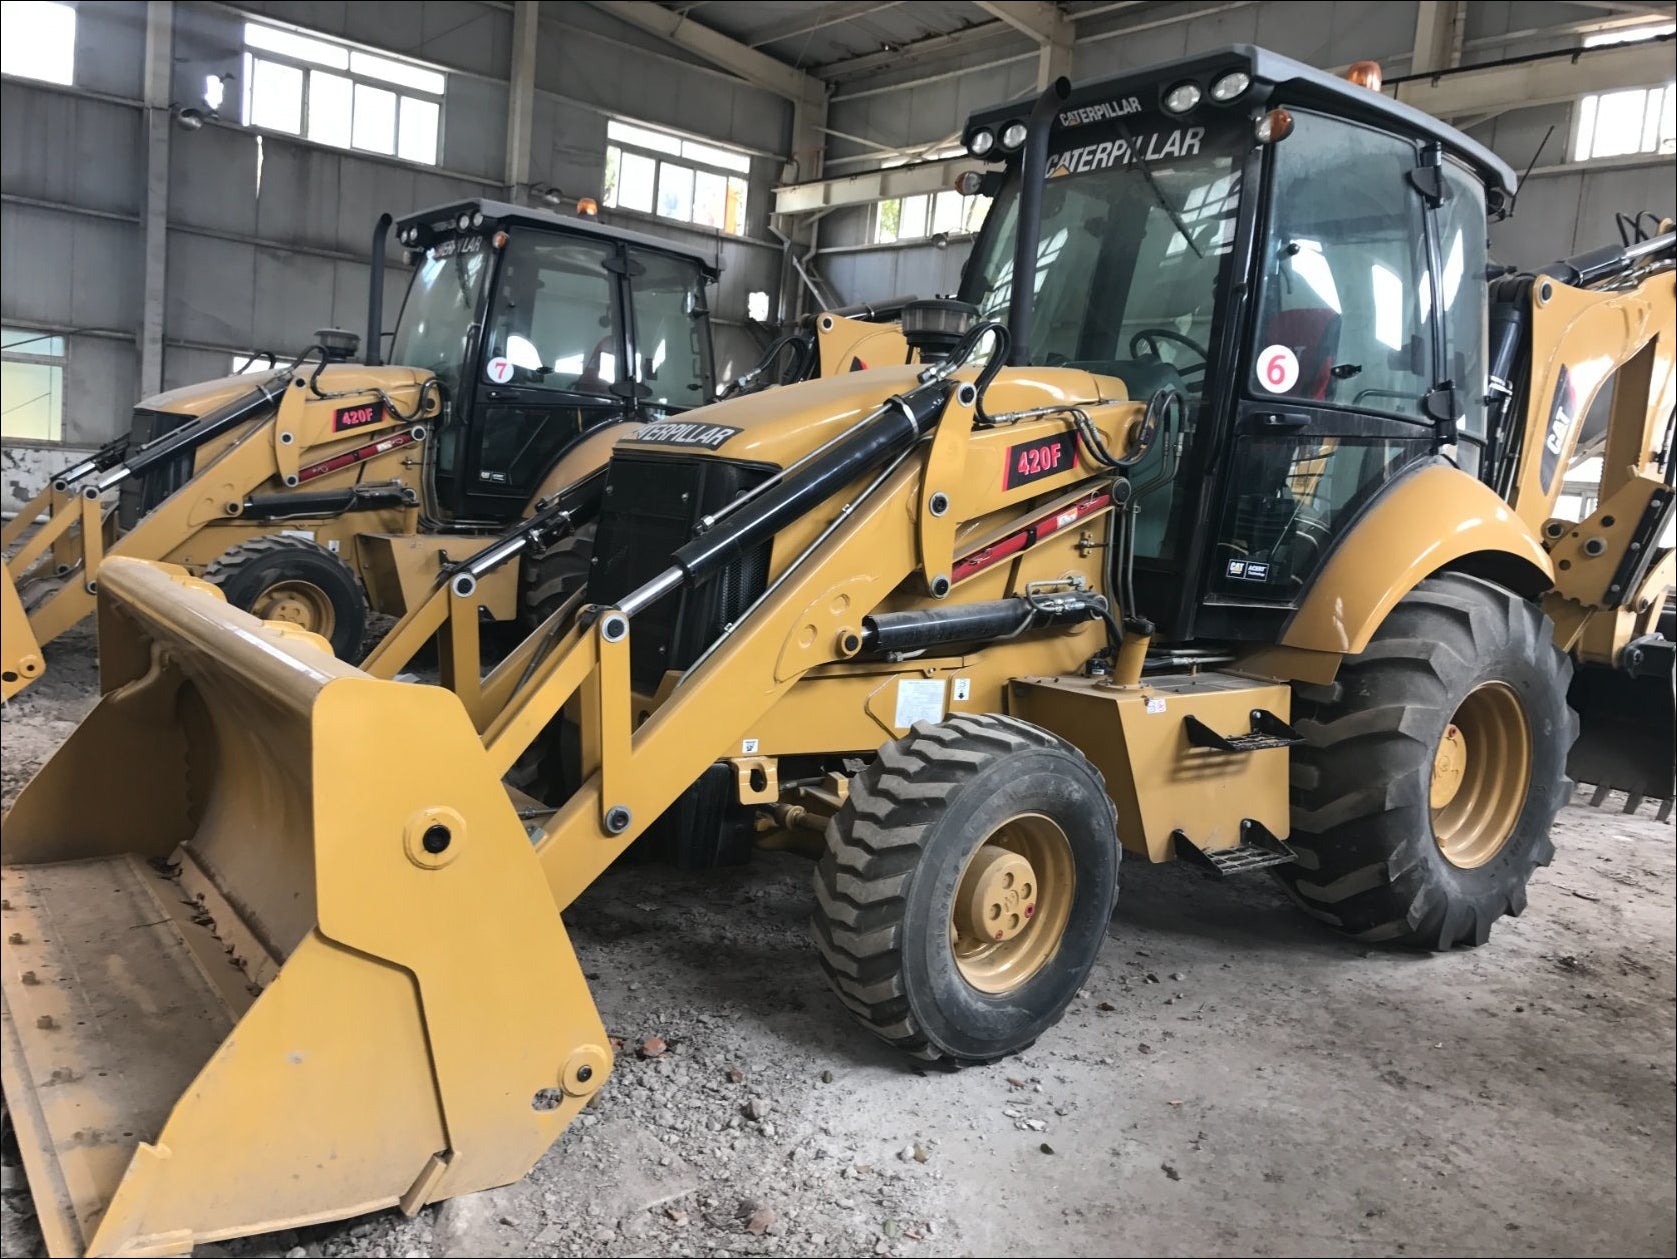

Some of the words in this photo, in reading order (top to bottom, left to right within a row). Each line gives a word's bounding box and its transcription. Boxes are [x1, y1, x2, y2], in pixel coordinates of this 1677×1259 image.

[1060, 97, 1142, 127] CATERPILLAR
[495, 362, 508, 380] 7
[1266, 354, 1286, 385] 6
[341, 407, 374, 426] 420F
[1546, 406, 1570, 455] CAT
[622, 422, 736, 446] TERPILLAR
[1017, 442, 1062, 476] 420F
